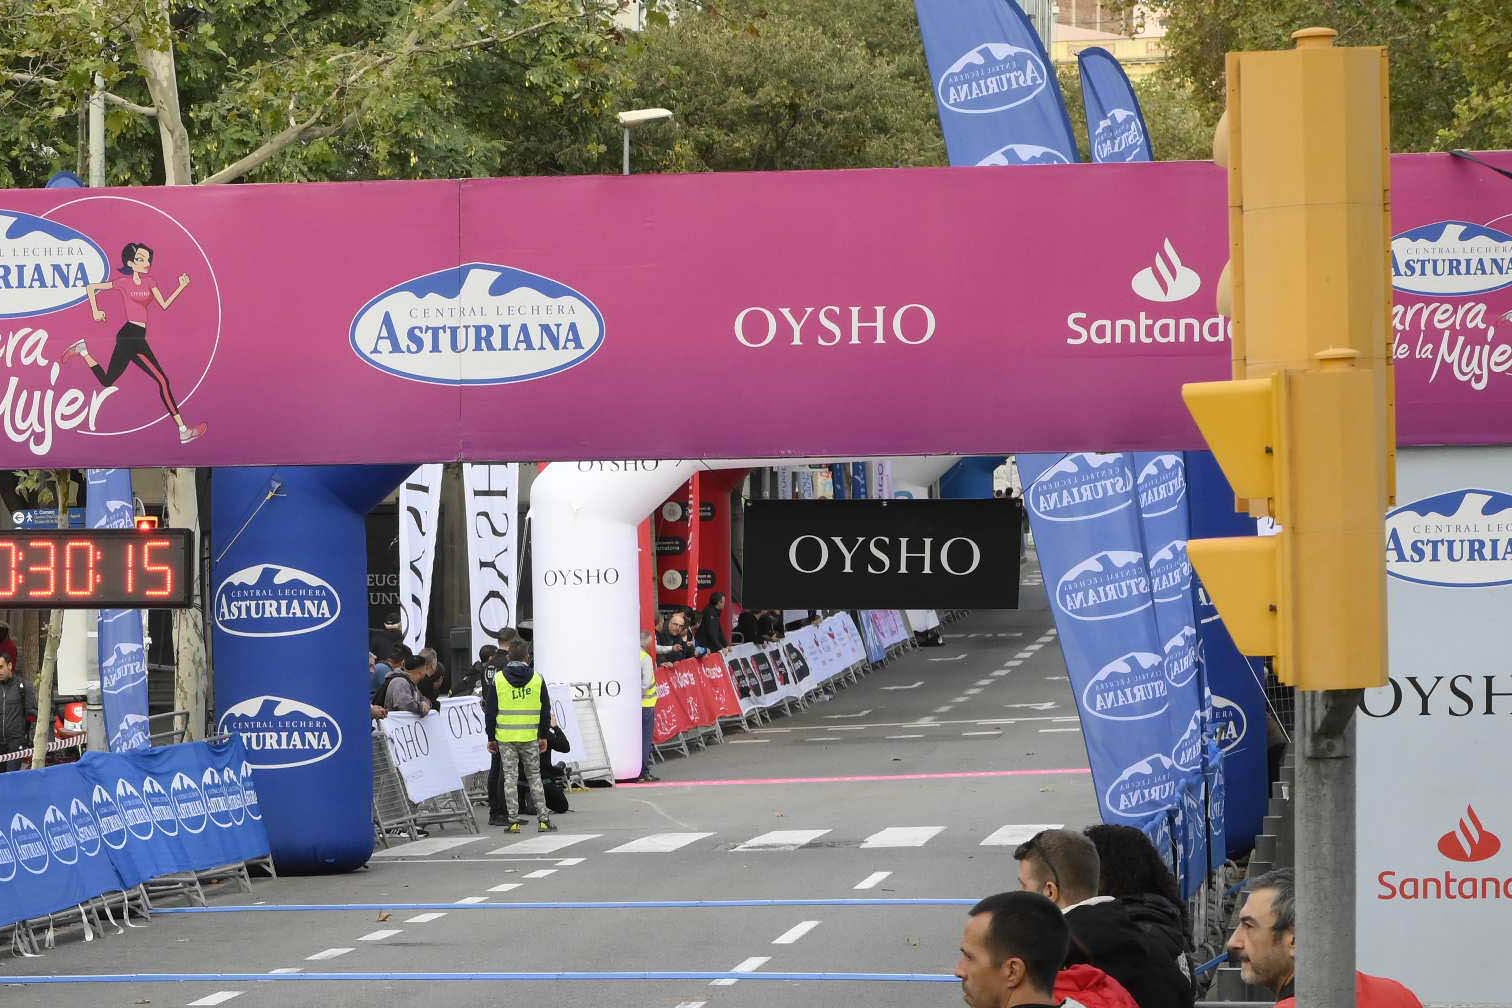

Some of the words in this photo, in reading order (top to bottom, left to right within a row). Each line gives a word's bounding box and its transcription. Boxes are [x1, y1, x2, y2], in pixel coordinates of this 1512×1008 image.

[12, 246, 86, 258] LECHERA
[409, 305, 476, 319] CENTRAL
[495, 303, 577, 317] LECHERA
[1392, 302, 1488, 331] arrera
[370, 310, 585, 355] ASTURIANA
[734, 304, 936, 348] OYSHO
[1415, 332, 1434, 359] la
[1428, 326, 1512, 391] Muje
[1412, 524, 1479, 534] CENTRAL
[788, 534, 981, 576] OYSHO
[1386, 526, 1512, 564] ASTURIA
[544, 567, 619, 587] OYSHO
[232, 588, 273, 597] CENTRAL
[278, 587, 327, 597] LECHERA
[219, 594, 331, 620] ASTURIANA
[512, 688, 531, 700] Life
[574, 681, 621, 698] SHO
[1357, 674, 1512, 719] OYSH
[233, 720, 273, 729] CENTRAL
[278, 719, 327, 729] LECHERA
[449, 703, 486, 740] OYS
[1377, 871, 1512, 901] Santan
